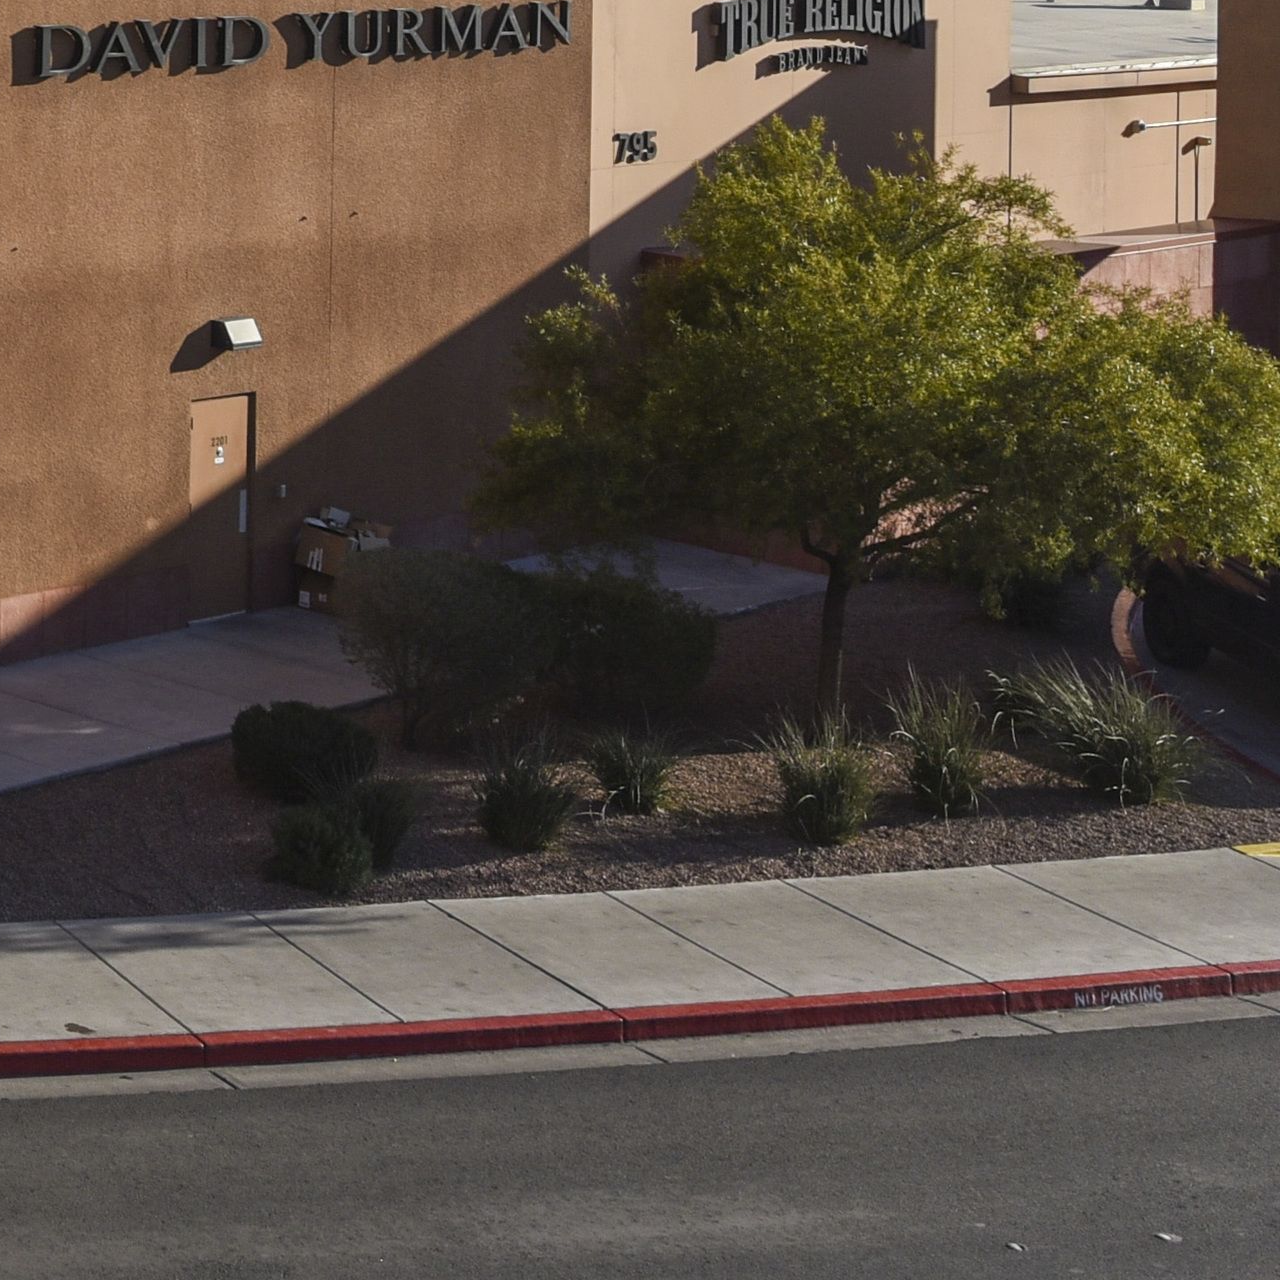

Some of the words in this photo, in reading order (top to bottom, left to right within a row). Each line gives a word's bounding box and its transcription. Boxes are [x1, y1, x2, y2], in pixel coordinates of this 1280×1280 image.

[33, 14, 271, 78] DAVID
[297, 0, 573, 62] YURMAN
[778, 47, 824, 73] BRAND
[613, 130, 658, 163] 795
[1074, 991, 1098, 1007] NO
[1100, 984, 1164, 1004] PARKING
